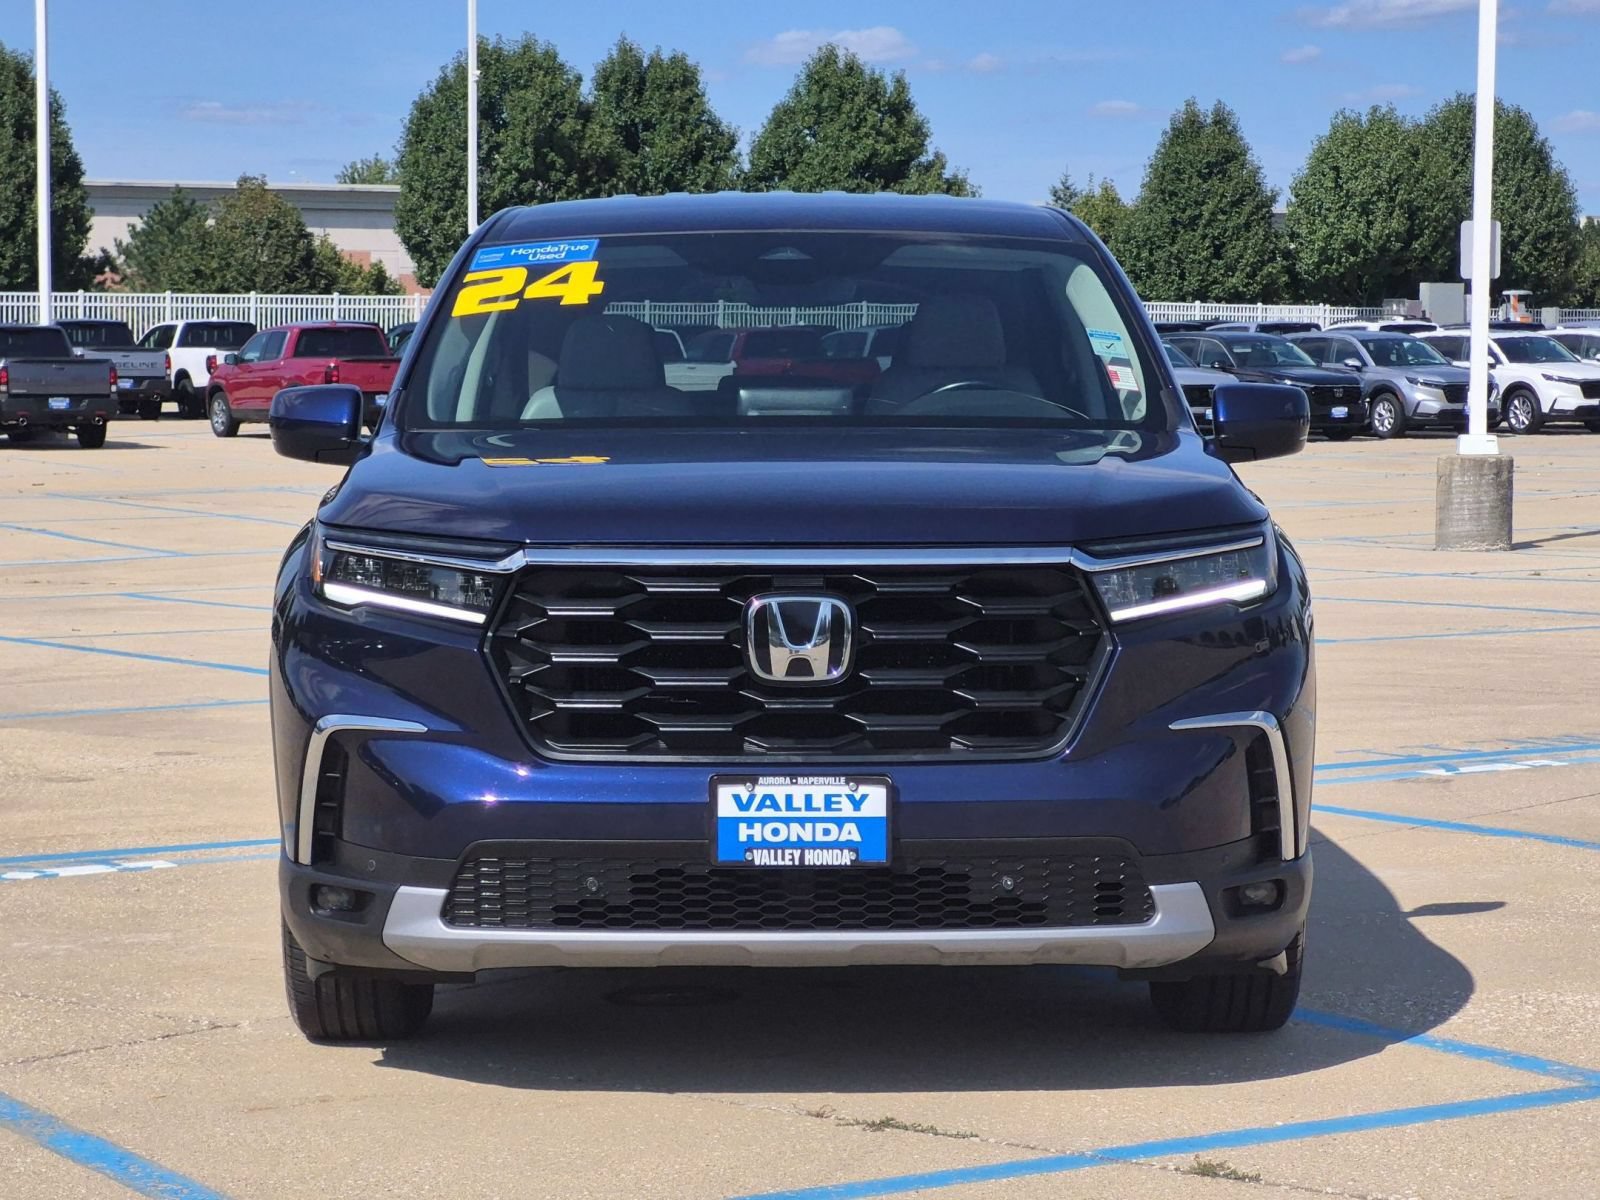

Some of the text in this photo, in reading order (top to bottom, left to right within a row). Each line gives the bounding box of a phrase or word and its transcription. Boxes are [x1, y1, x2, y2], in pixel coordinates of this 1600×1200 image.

[511, 244, 589, 256] HondaTrue
[528, 252, 566, 261] Used
[452, 261, 604, 317] 24
[758, 777, 846, 785] AURORA NAPERVILLE
[732, 793, 870, 812] VALLEY
[738, 822, 862, 842] HONDA
[753, 849, 851, 866] VALLEY HONDA
